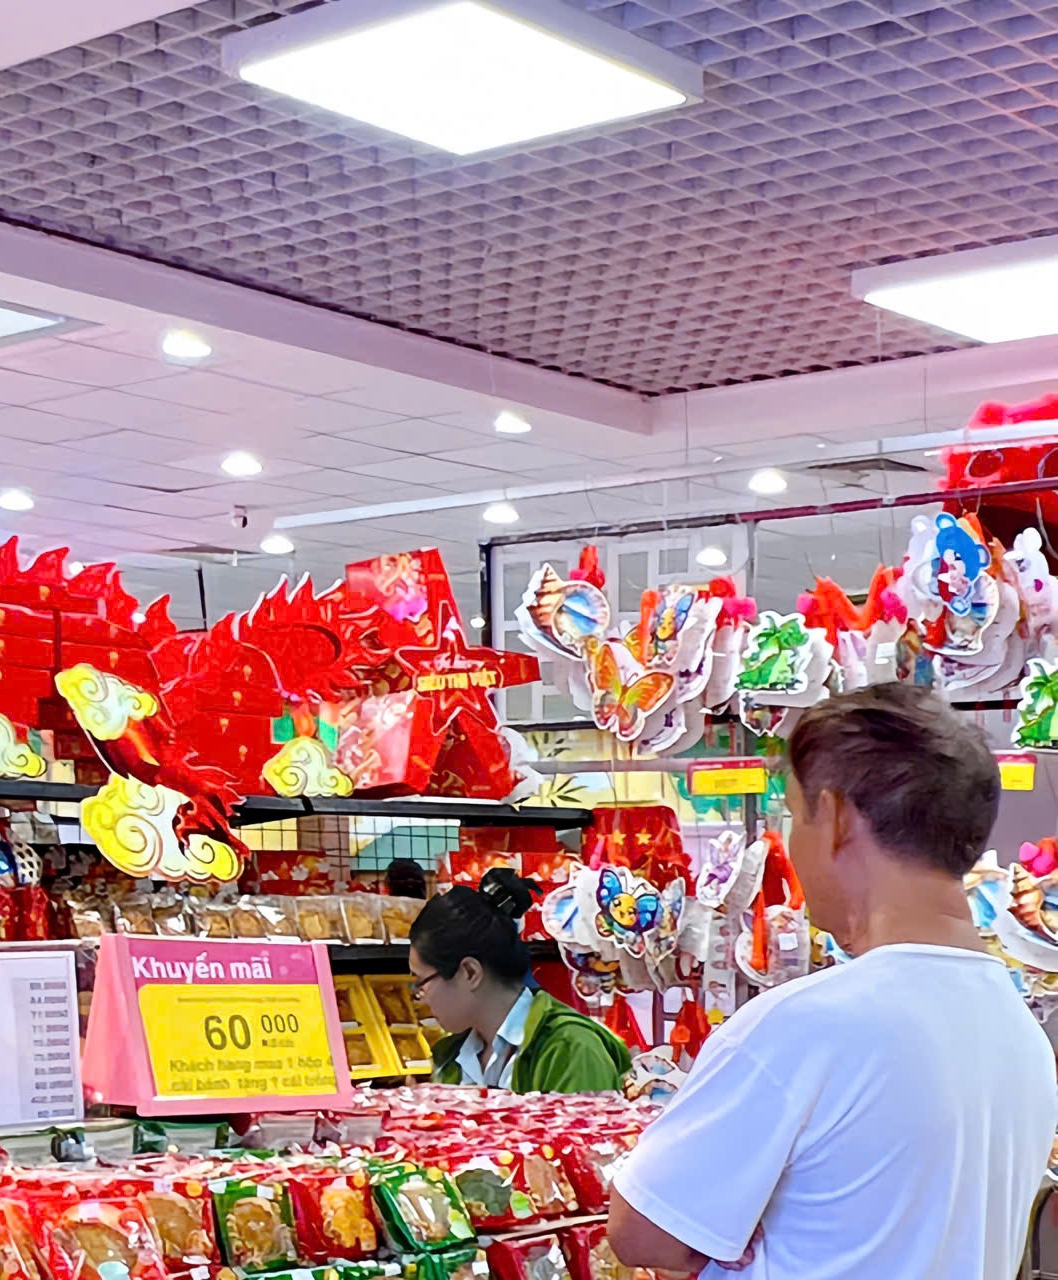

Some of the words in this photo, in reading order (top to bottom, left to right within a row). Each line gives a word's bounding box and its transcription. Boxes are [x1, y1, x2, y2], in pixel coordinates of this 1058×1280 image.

[132, 951, 226, 984] Khuyến
[230, 956, 272, 980] mãi
[204, 1014, 252, 1050] 60
[261, 1013, 300, 1033] 000
